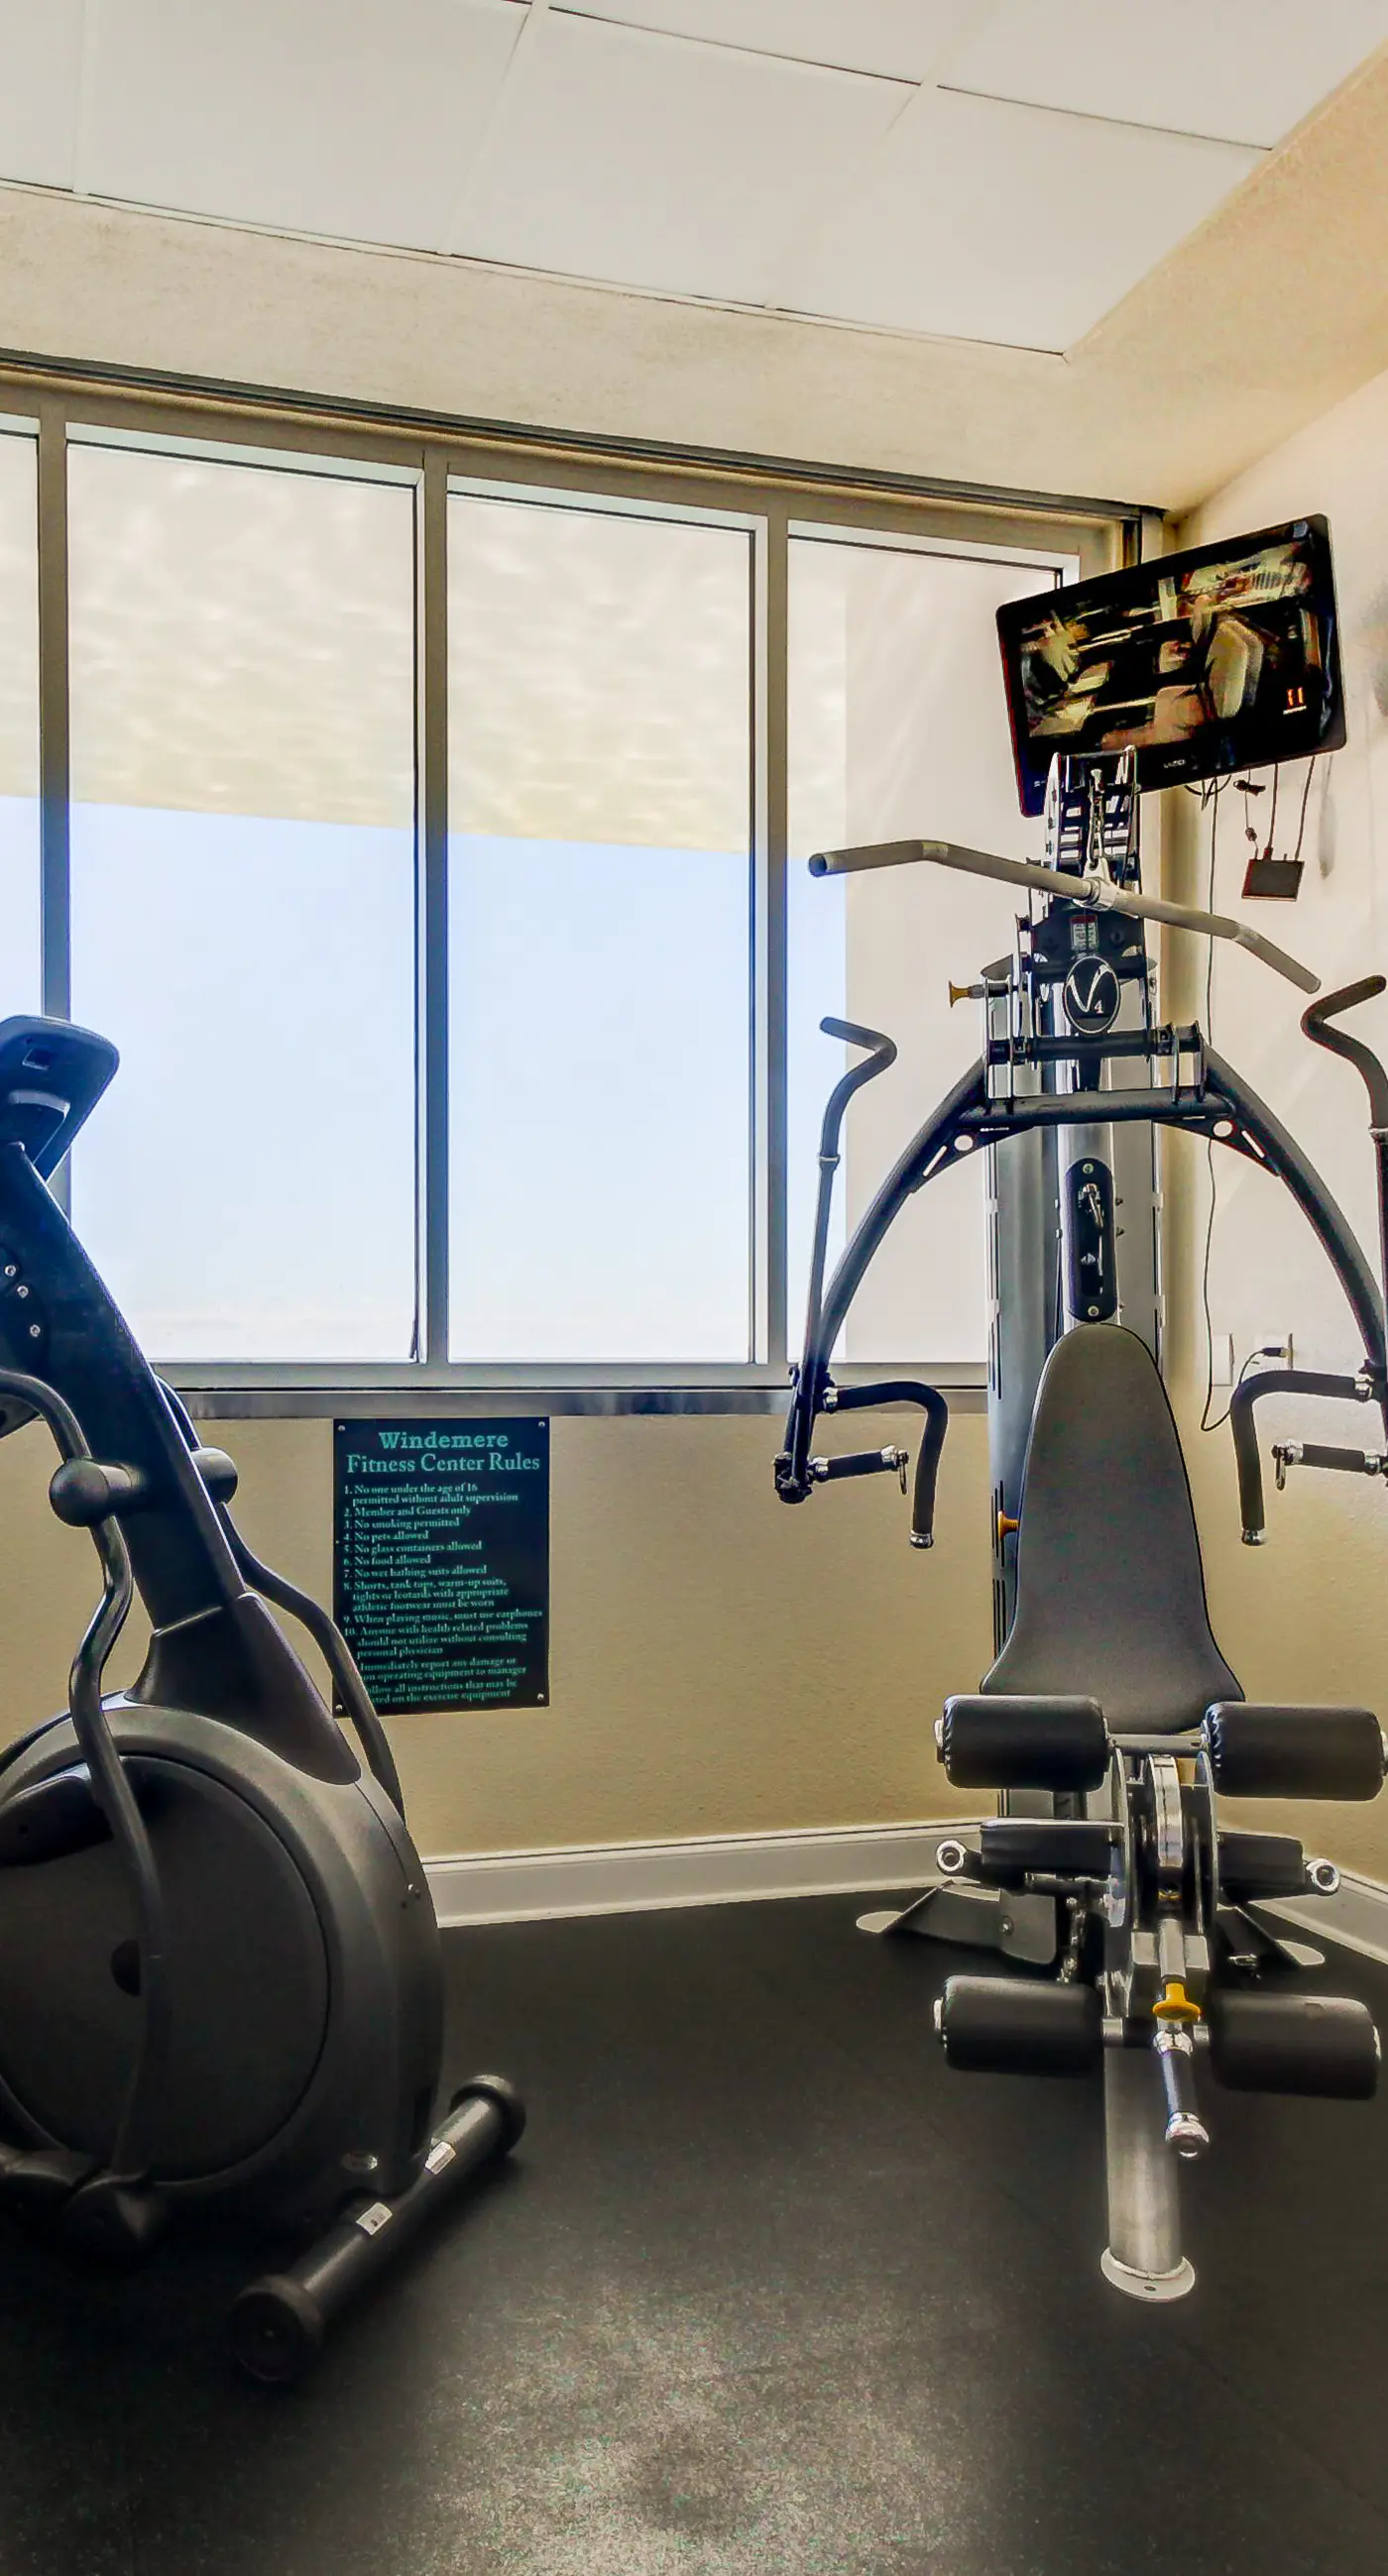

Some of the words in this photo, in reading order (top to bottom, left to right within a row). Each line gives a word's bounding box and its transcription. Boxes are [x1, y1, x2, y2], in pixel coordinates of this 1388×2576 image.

[379, 1431, 509, 1449] Windemere
[347, 1454, 415, 1473] Fitness
[420, 1453, 486, 1472] Center
[488, 1452, 540, 1471] Rules
[344, 1485, 353, 1495] 1.
[354, 1484, 370, 1495] No
[391, 1483, 419, 1494] under
[419, 1483, 436, 1494] the
[437, 1486, 453, 1496] age
[454, 1482, 467, 1493] of
[352, 1494, 400, 1508] permitted
[401, 1494, 437, 1504] without
[439, 1493, 464, 1503] adult
[465, 1492, 519, 1505] supervision
[344, 1508, 353, 1517] 2.
[354, 1507, 396, 1517] Member
[397, 1506, 414, 1515] and
[416, 1506, 450, 1515] Guests
[450, 1505, 471, 1516] only
[354, 1519, 370, 1529] No
[371, 1518, 412, 1530] smoking
[413, 1516, 460, 1531] permitted
[354, 1531, 370, 1541] No
[371, 1533, 392, 1544] pets
[392, 1529, 429, 1540] allowed
[354, 1543, 370, 1553] No
[371, 1543, 395, 1555] glass
[396, 1543, 446, 1553] containers
[446, 1540, 483, 1551] allowed
[354, 1556, 370, 1565] No
[371, 1554, 394, 1565] food
[395, 1553, 431, 1564] allowed
[354, 1569, 371, 1579] No
[371, 1569, 388, 1578] wet
[390, 1567, 426, 1579] bathing
[451, 1564, 487, 1575] allowed
[390, 1579, 412, 1589] tank
[352, 1590, 380, 1603] tights
[432, 1588, 454, 1598] with
[455, 1588, 510, 1600] appropriate
[457, 1598, 469, 1608] be
[470, 1599, 495, 1608] worn
[354, 1614, 384, 1624] When
[398, 1625, 420, 1635] with
[420, 1623, 451, 1634] health
[439, 1633, 477, 1644] without
[424, 1668, 475, 1682] equipment
[367, 1684, 393, 1696] ollow
